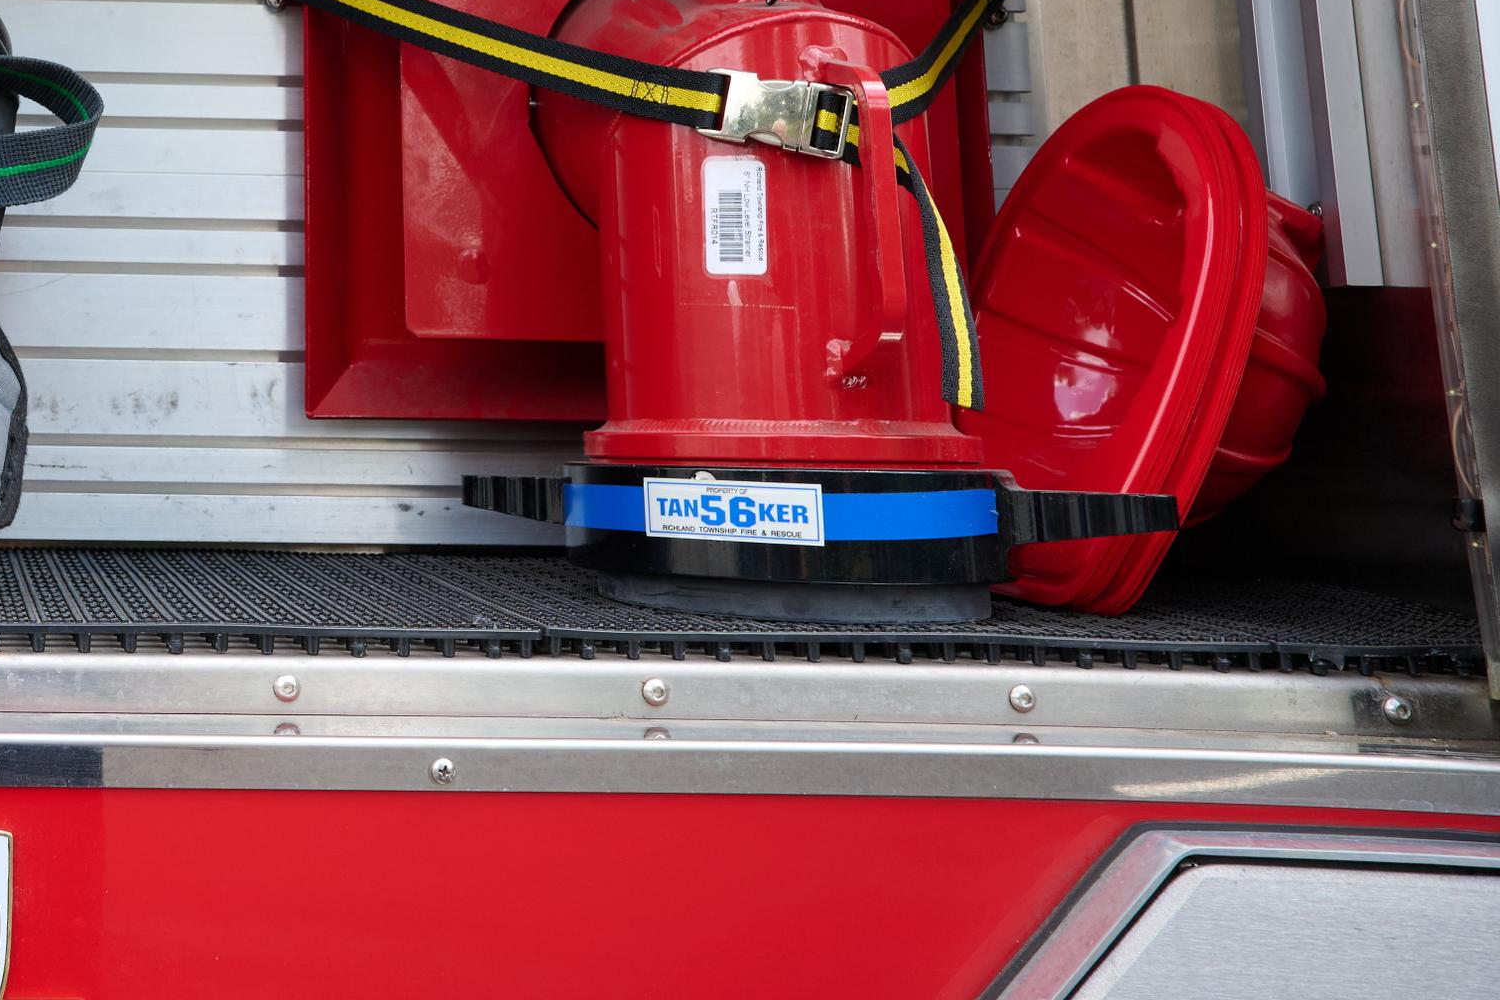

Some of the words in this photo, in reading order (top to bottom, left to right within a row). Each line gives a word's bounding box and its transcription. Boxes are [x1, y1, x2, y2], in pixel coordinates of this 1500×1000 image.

[706, 487, 738, 495] PROPERTY
[662, 524, 696, 532] RICHLAND
[699, 526, 737, 534] TOWNSHIP
[741, 528, 757, 536] FIRE
[771, 530, 802, 538] RESCUE
